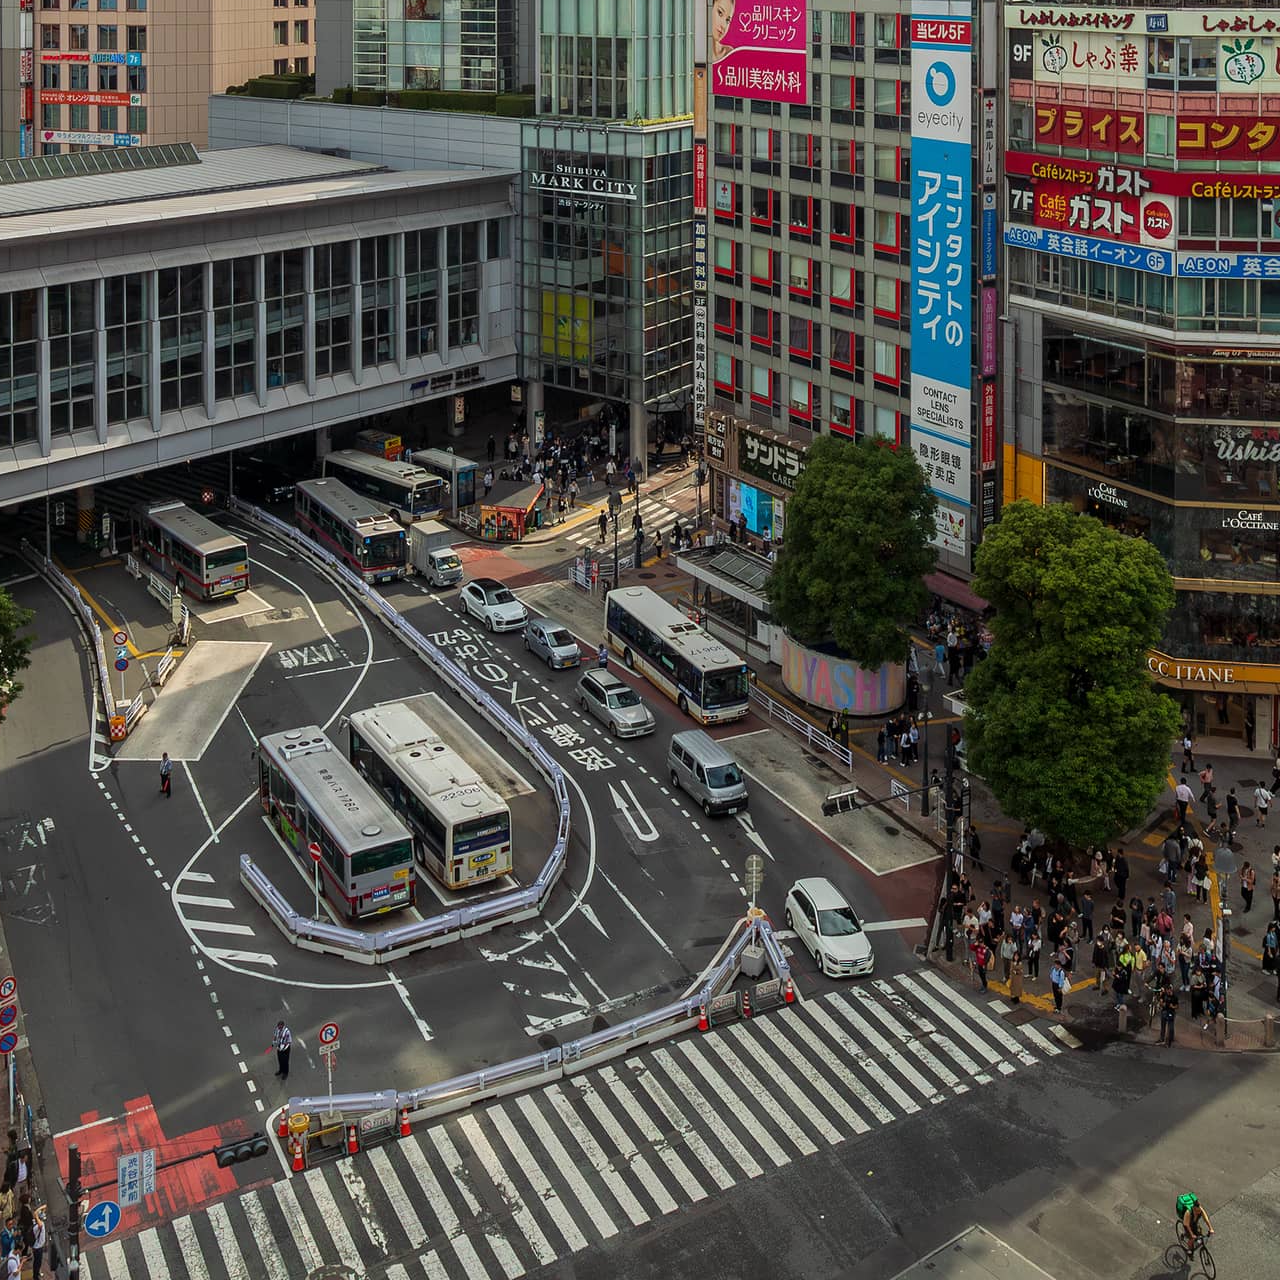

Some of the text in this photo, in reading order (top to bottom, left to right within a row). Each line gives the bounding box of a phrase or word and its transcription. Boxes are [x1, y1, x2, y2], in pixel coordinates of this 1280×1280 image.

[751, 4, 802, 24] 品川スキン
[1020, 9, 1166, 30] しゃぶしゃぶバイキング 寿司
[751, 25, 796, 42] クリニック
[916, 22, 966, 41] 当ビル5F
[1013, 44, 1032, 62] 9F
[1072, 41, 1139, 73] しゃぶ葉
[725, 66, 802, 94] 品川美容外科
[917, 110, 964, 132] eyecity
[1036, 107, 1142, 144] プライス
[556, 164, 607, 177] SHIBUYA
[1097, 166, 1151, 196] ガスト
[531, 172, 637, 195] MARK CITY
[1011, 189, 1033, 211] 7F
[1039, 193, 1066, 211] Café
[1039, 209, 1066, 221] レストラン
[1069, 195, 1134, 234] ガスト
[1147, 217, 1169, 229] ガスト
[917, 169, 942, 340] アイシティ
[1009, 228, 1164, 268] AEON 英会話イーオン 6F
[945, 174, 964, 346] コンタクトの
[1184, 258, 1230, 272] AEON
[923, 386, 958, 405] CONTACT
[930, 399, 950, 414] LENS
[917, 407, 964, 430] SPECIALISTS
[1238, 510, 1263, 522] CAFÉ
